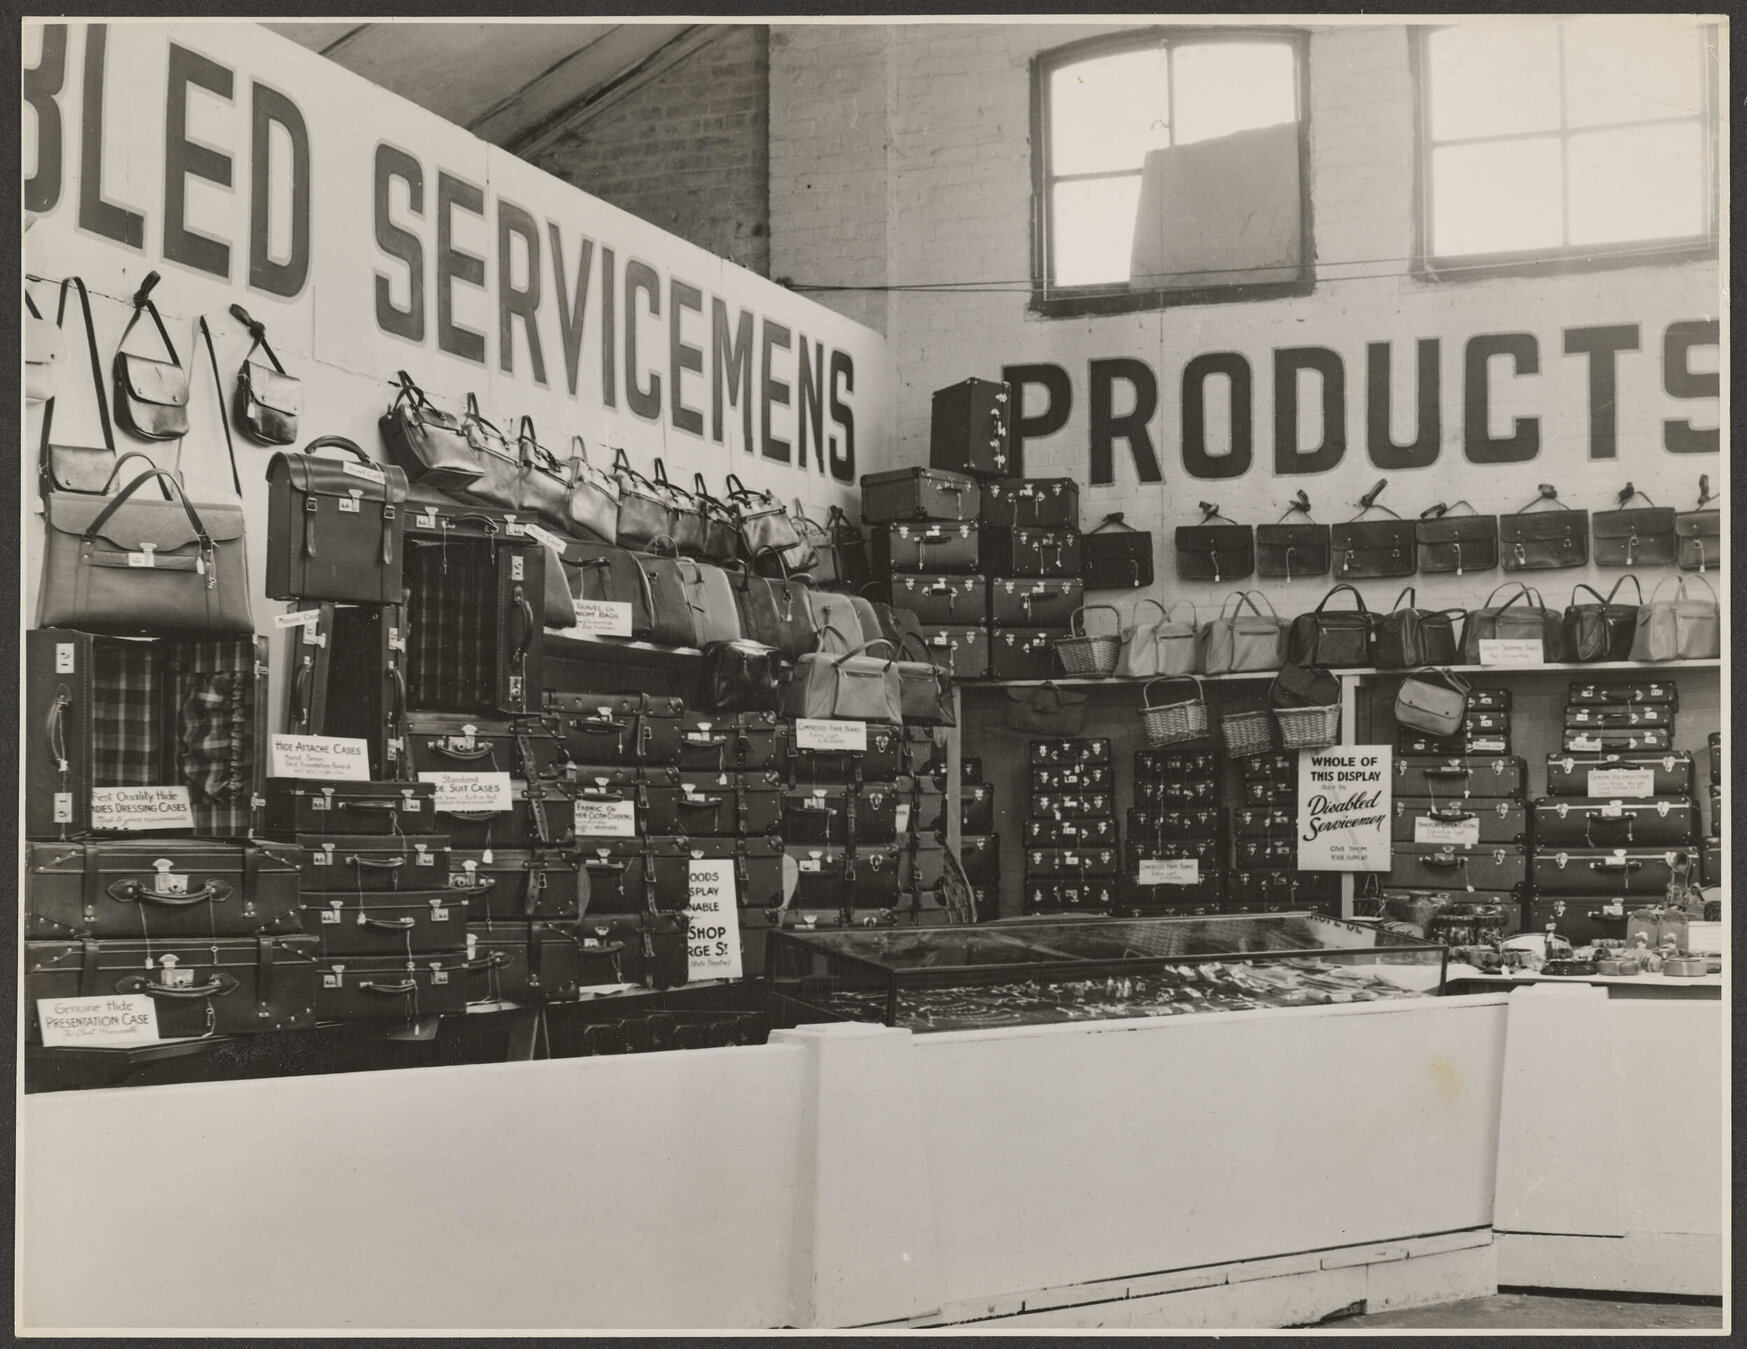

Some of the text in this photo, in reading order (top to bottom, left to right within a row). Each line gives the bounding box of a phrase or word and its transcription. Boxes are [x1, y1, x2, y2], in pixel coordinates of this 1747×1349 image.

[374, 142, 856, 483] SERVICEMENS
[1002, 319, 1720, 485] PRODUCTS
[576, 602, 602, 613] TRAVEL
[275, 740, 361, 756] HIDE ATTACHE CASES
[1311, 757, 1379, 767] WHOLE OF
[442, 774, 479, 784] Standard
[1310, 771, 1381, 782] THIS DISPLAY
[449, 783, 468, 793] SUIT
[470, 783, 500, 793] CASES
[115, 790, 153, 803] Quality
[156, 790, 178, 801] Hide
[115, 803, 157, 813] DRESSING
[158, 802, 187, 813] CASES
[1308, 790, 1382, 816] Disabled
[1303, 814, 1386, 842] Servicemen
[1330, 845, 1345, 853] GIVE
[689, 872, 719, 882] OODS
[688, 887, 719, 896] SPLAY
[688, 902, 719, 912] NABLE
[688, 925, 726, 940] SHOP
[688, 945, 711, 957] RGE
[54, 1000, 134, 1015] Genuine Hide
[45, 1012, 150, 1029] PRESENTATION CASE
